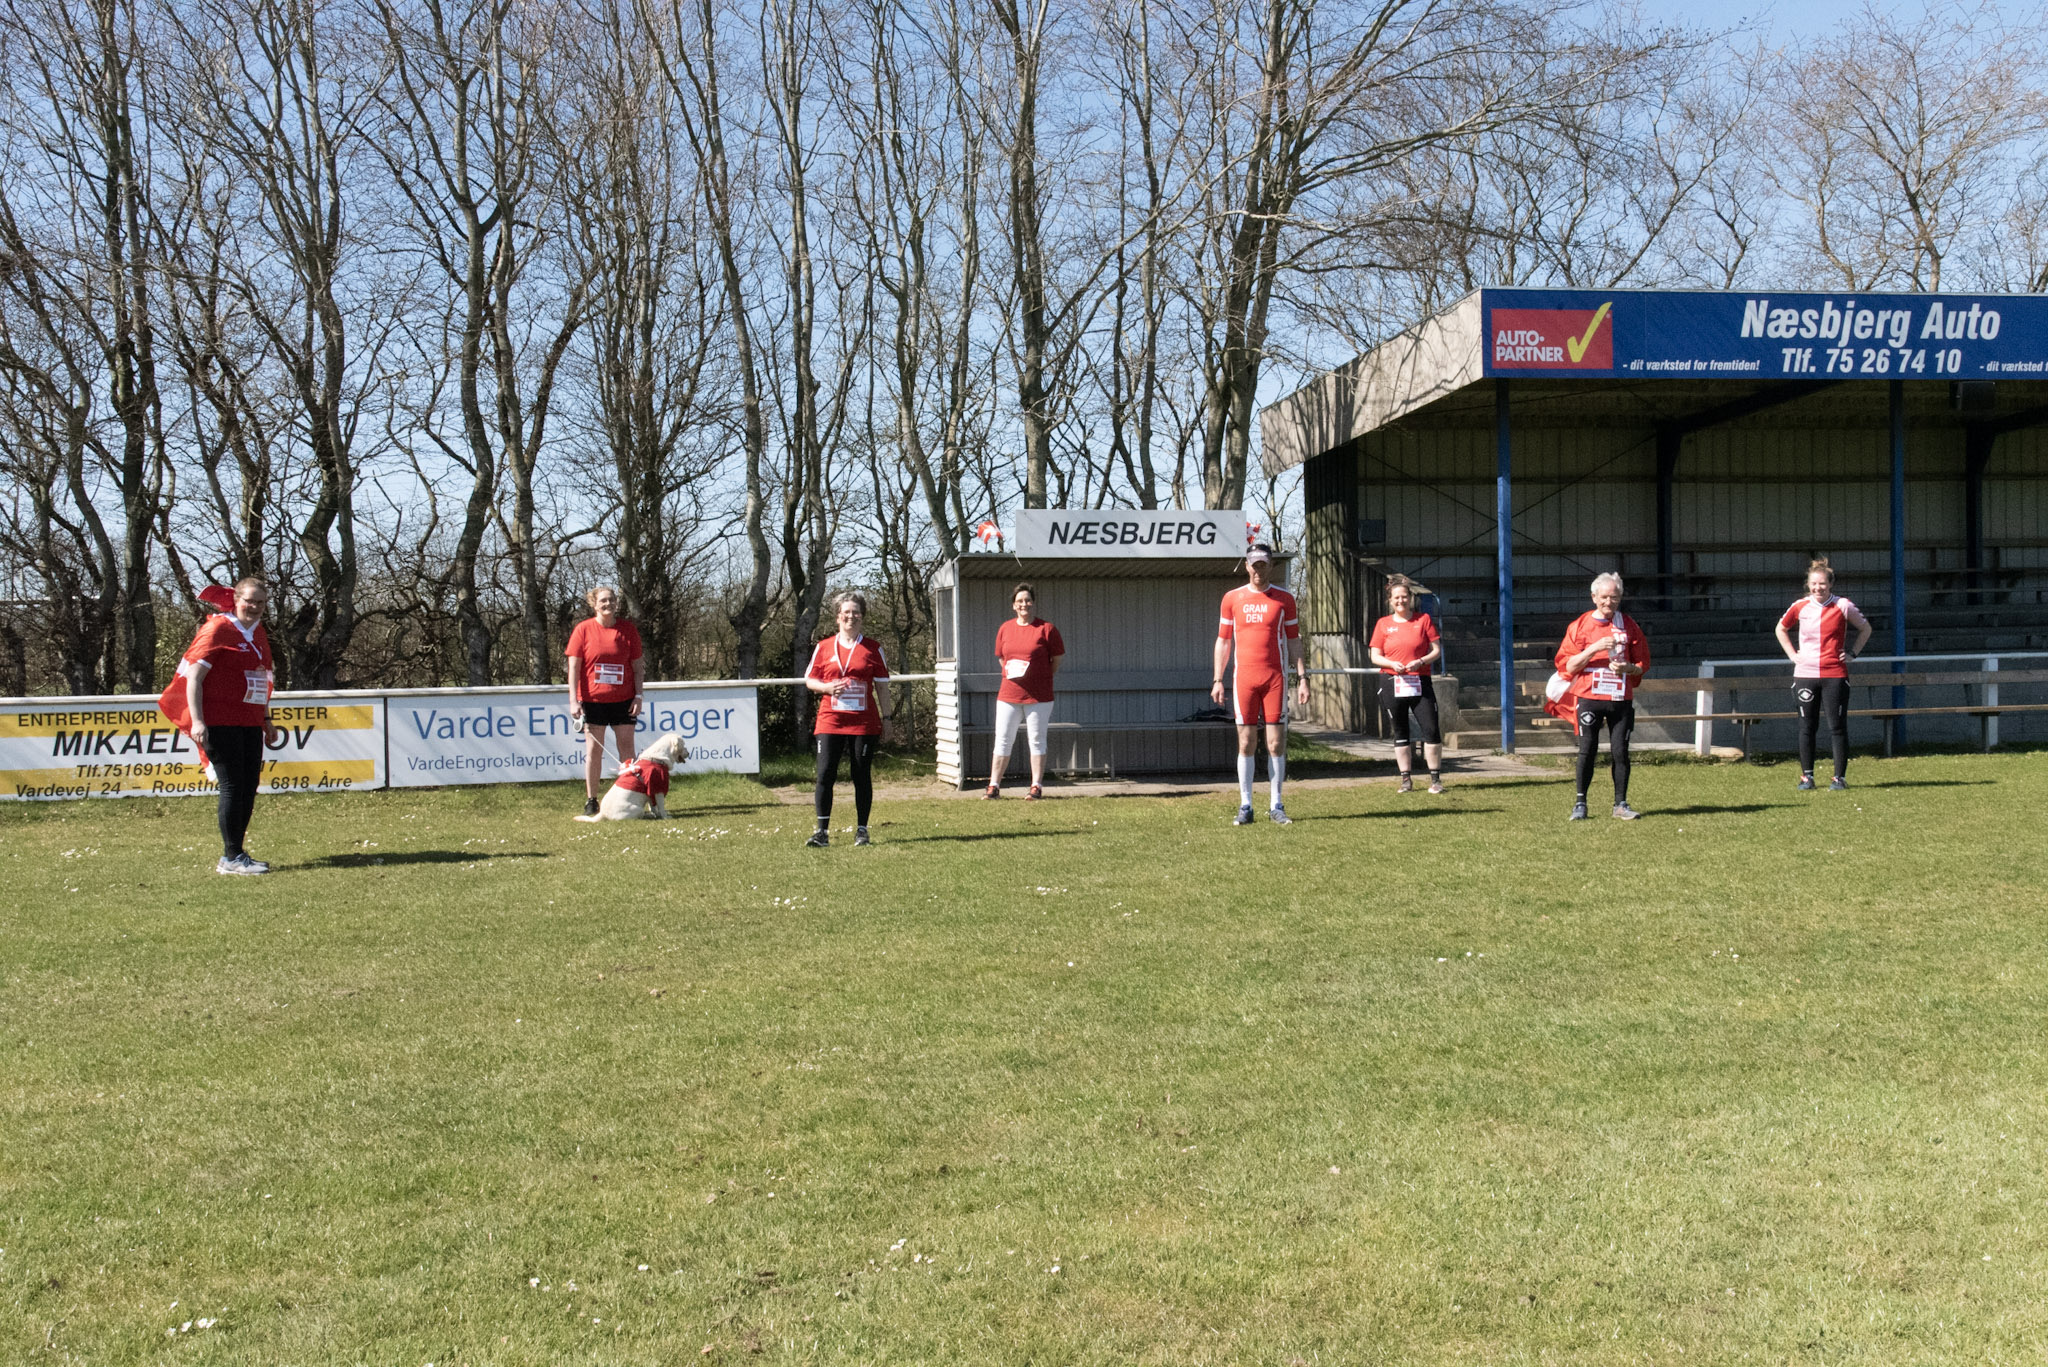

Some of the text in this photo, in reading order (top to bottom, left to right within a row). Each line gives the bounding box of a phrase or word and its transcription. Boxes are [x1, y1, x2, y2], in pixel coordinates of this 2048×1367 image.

[1740, 300, 2001, 349] Næsbjerg Auto
[1496, 346, 1565, 362] PARTNER
[1630, 359, 1644, 371] dit
[1646, 359, 1690, 371] værksted
[1693, 359, 1708, 371] for
[1709, 359, 1761, 371] fremtiden!
[1782, 348, 1962, 374] Tlf. 75 26 74 10
[1986, 361, 1999, 372] dit
[2001, 361, 2044, 372] værksted
[1048, 521, 1217, 545] NÆSBJERG
[1242, 603, 1268, 614] GRAM
[1245, 613, 1263, 624] DEN
[18, 707, 328, 727] ENTREPRENØR ESTER
[412, 702, 735, 746] Varde Enslager
[52, 728, 190, 757] MIKAEL
[407, 751, 587, 773] VardeEngroslavpris.dk
[16, 782, 91, 798] Vardevej
[101, 782, 121, 795] 24
[271, 775, 310, 790] 6818
[317, 770, 353, 788] Årre
